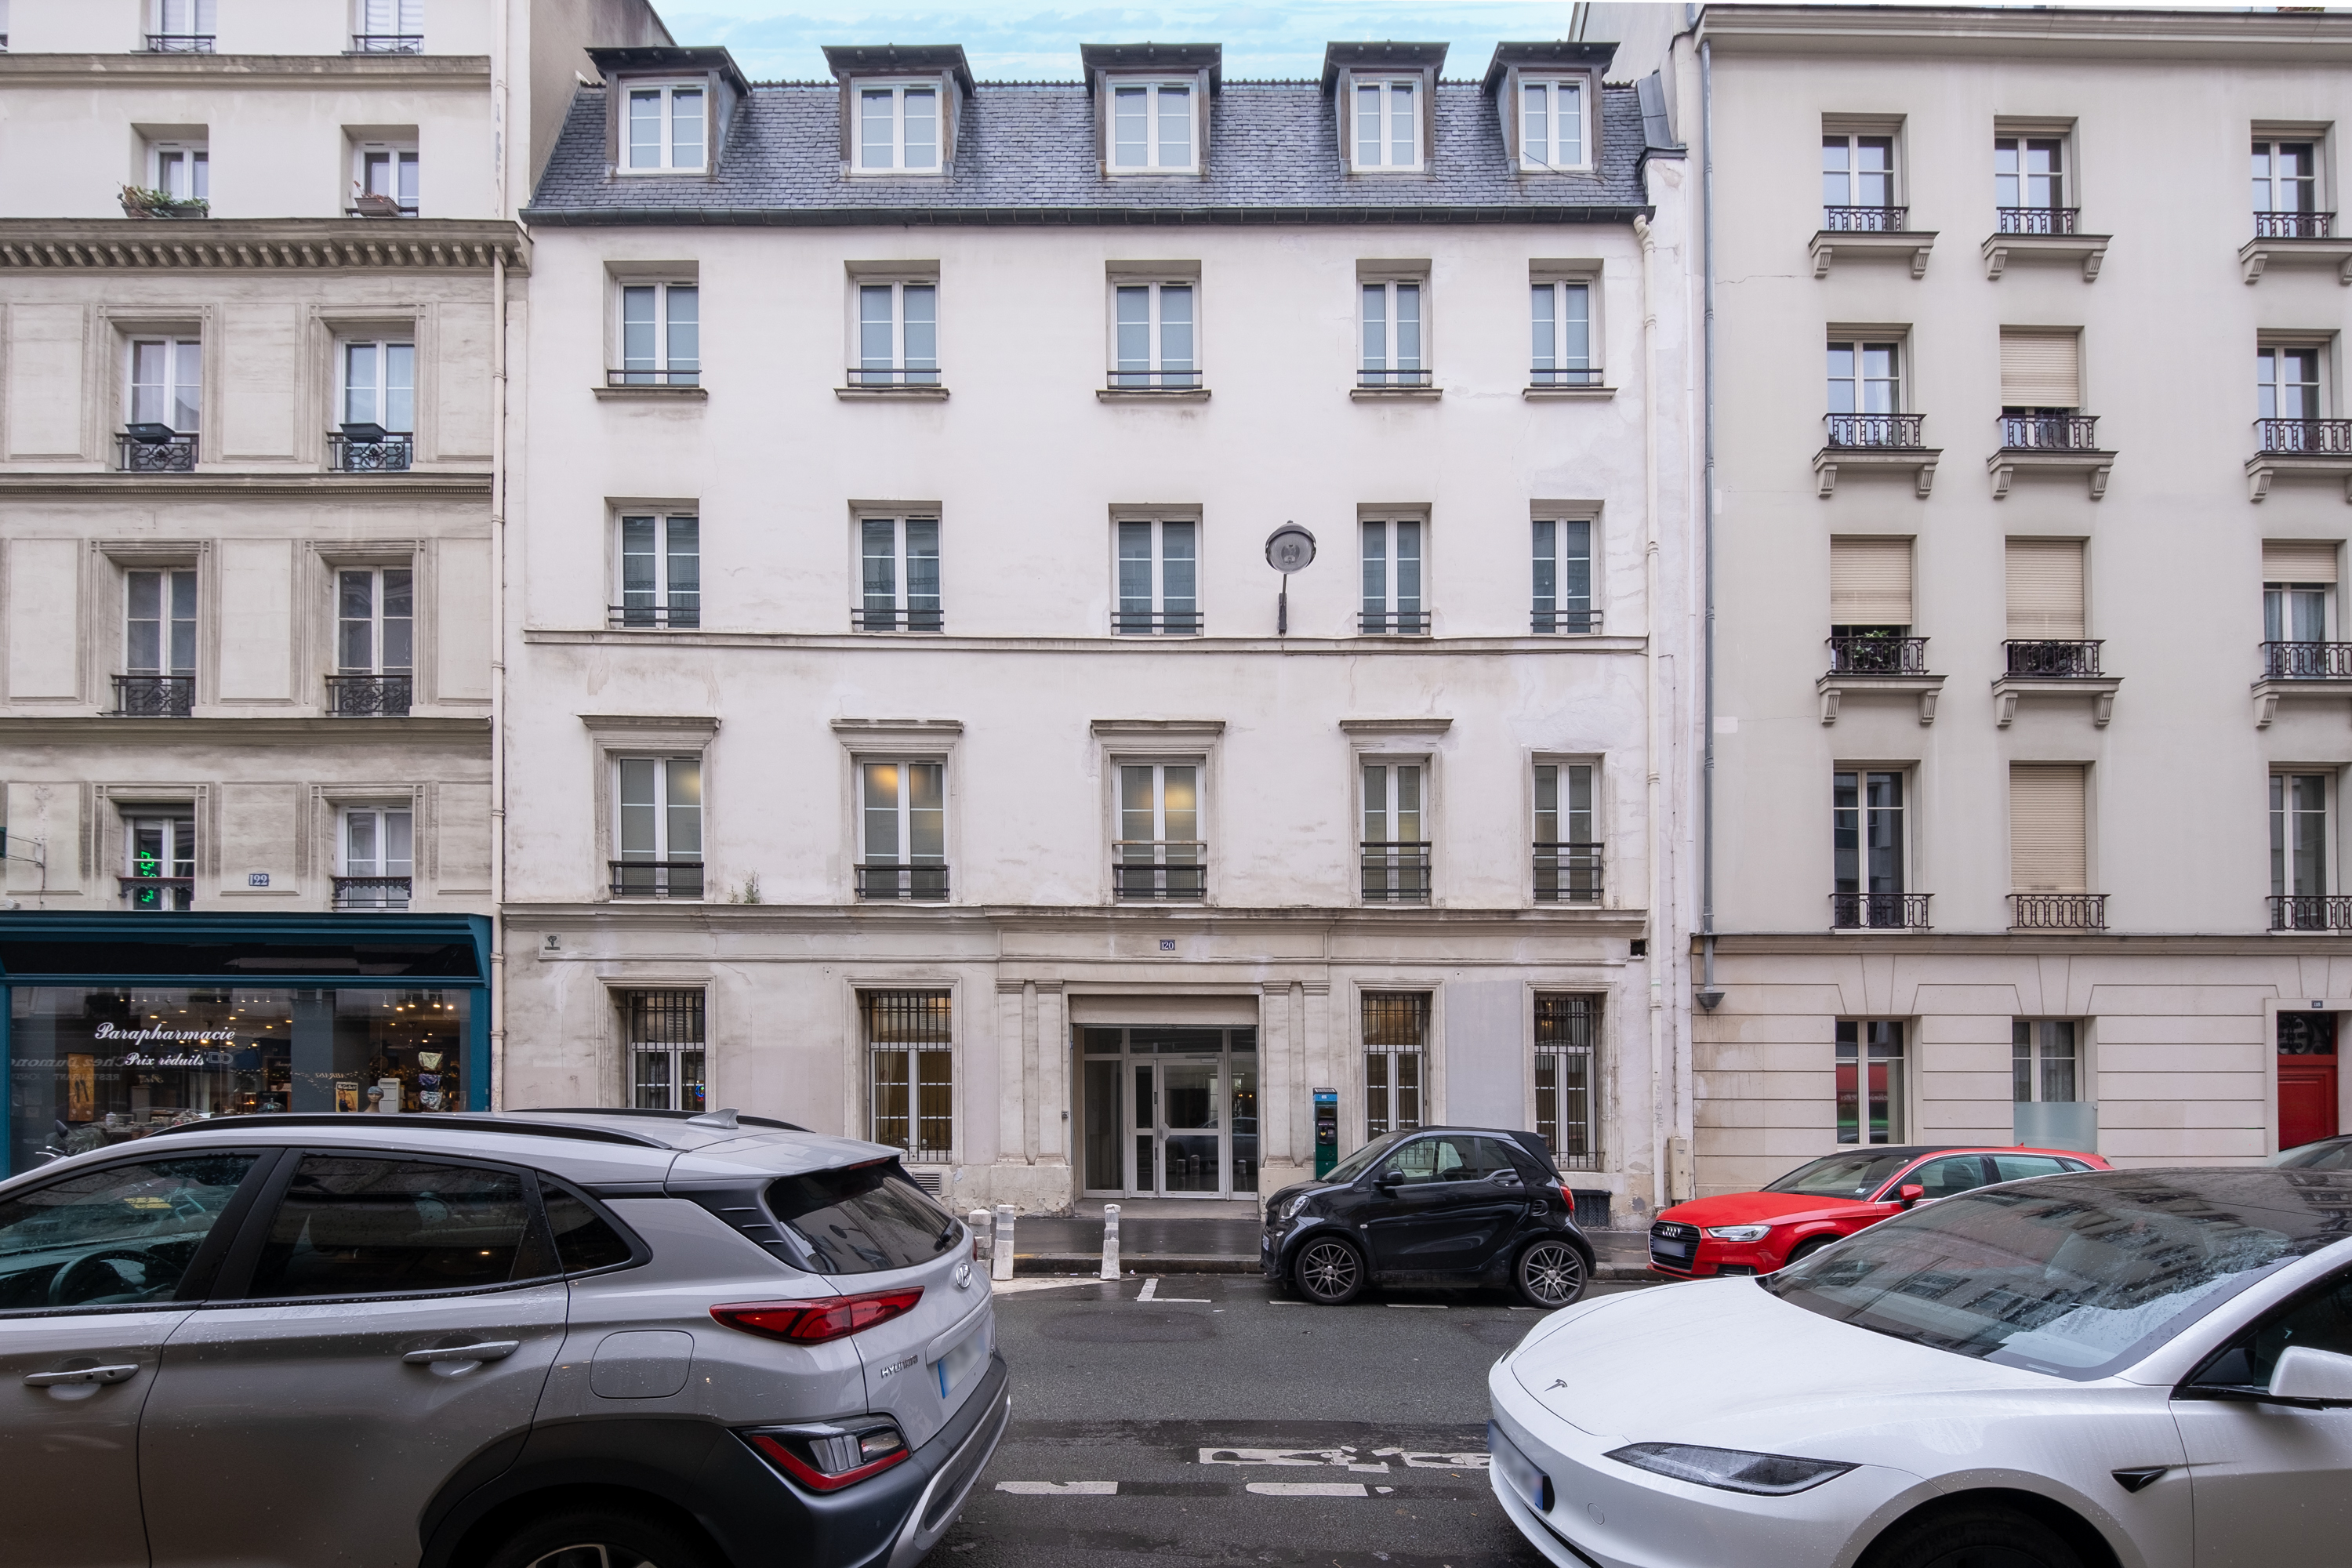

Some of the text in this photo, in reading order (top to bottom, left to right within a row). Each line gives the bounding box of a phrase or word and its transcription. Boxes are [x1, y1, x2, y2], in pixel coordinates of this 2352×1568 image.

[250, 874, 267, 885] 122
[1161, 942, 1174, 950] 120
[95, 1022, 235, 1045] Parapharmacie
[125, 1052, 205, 1065] Prix réduits
